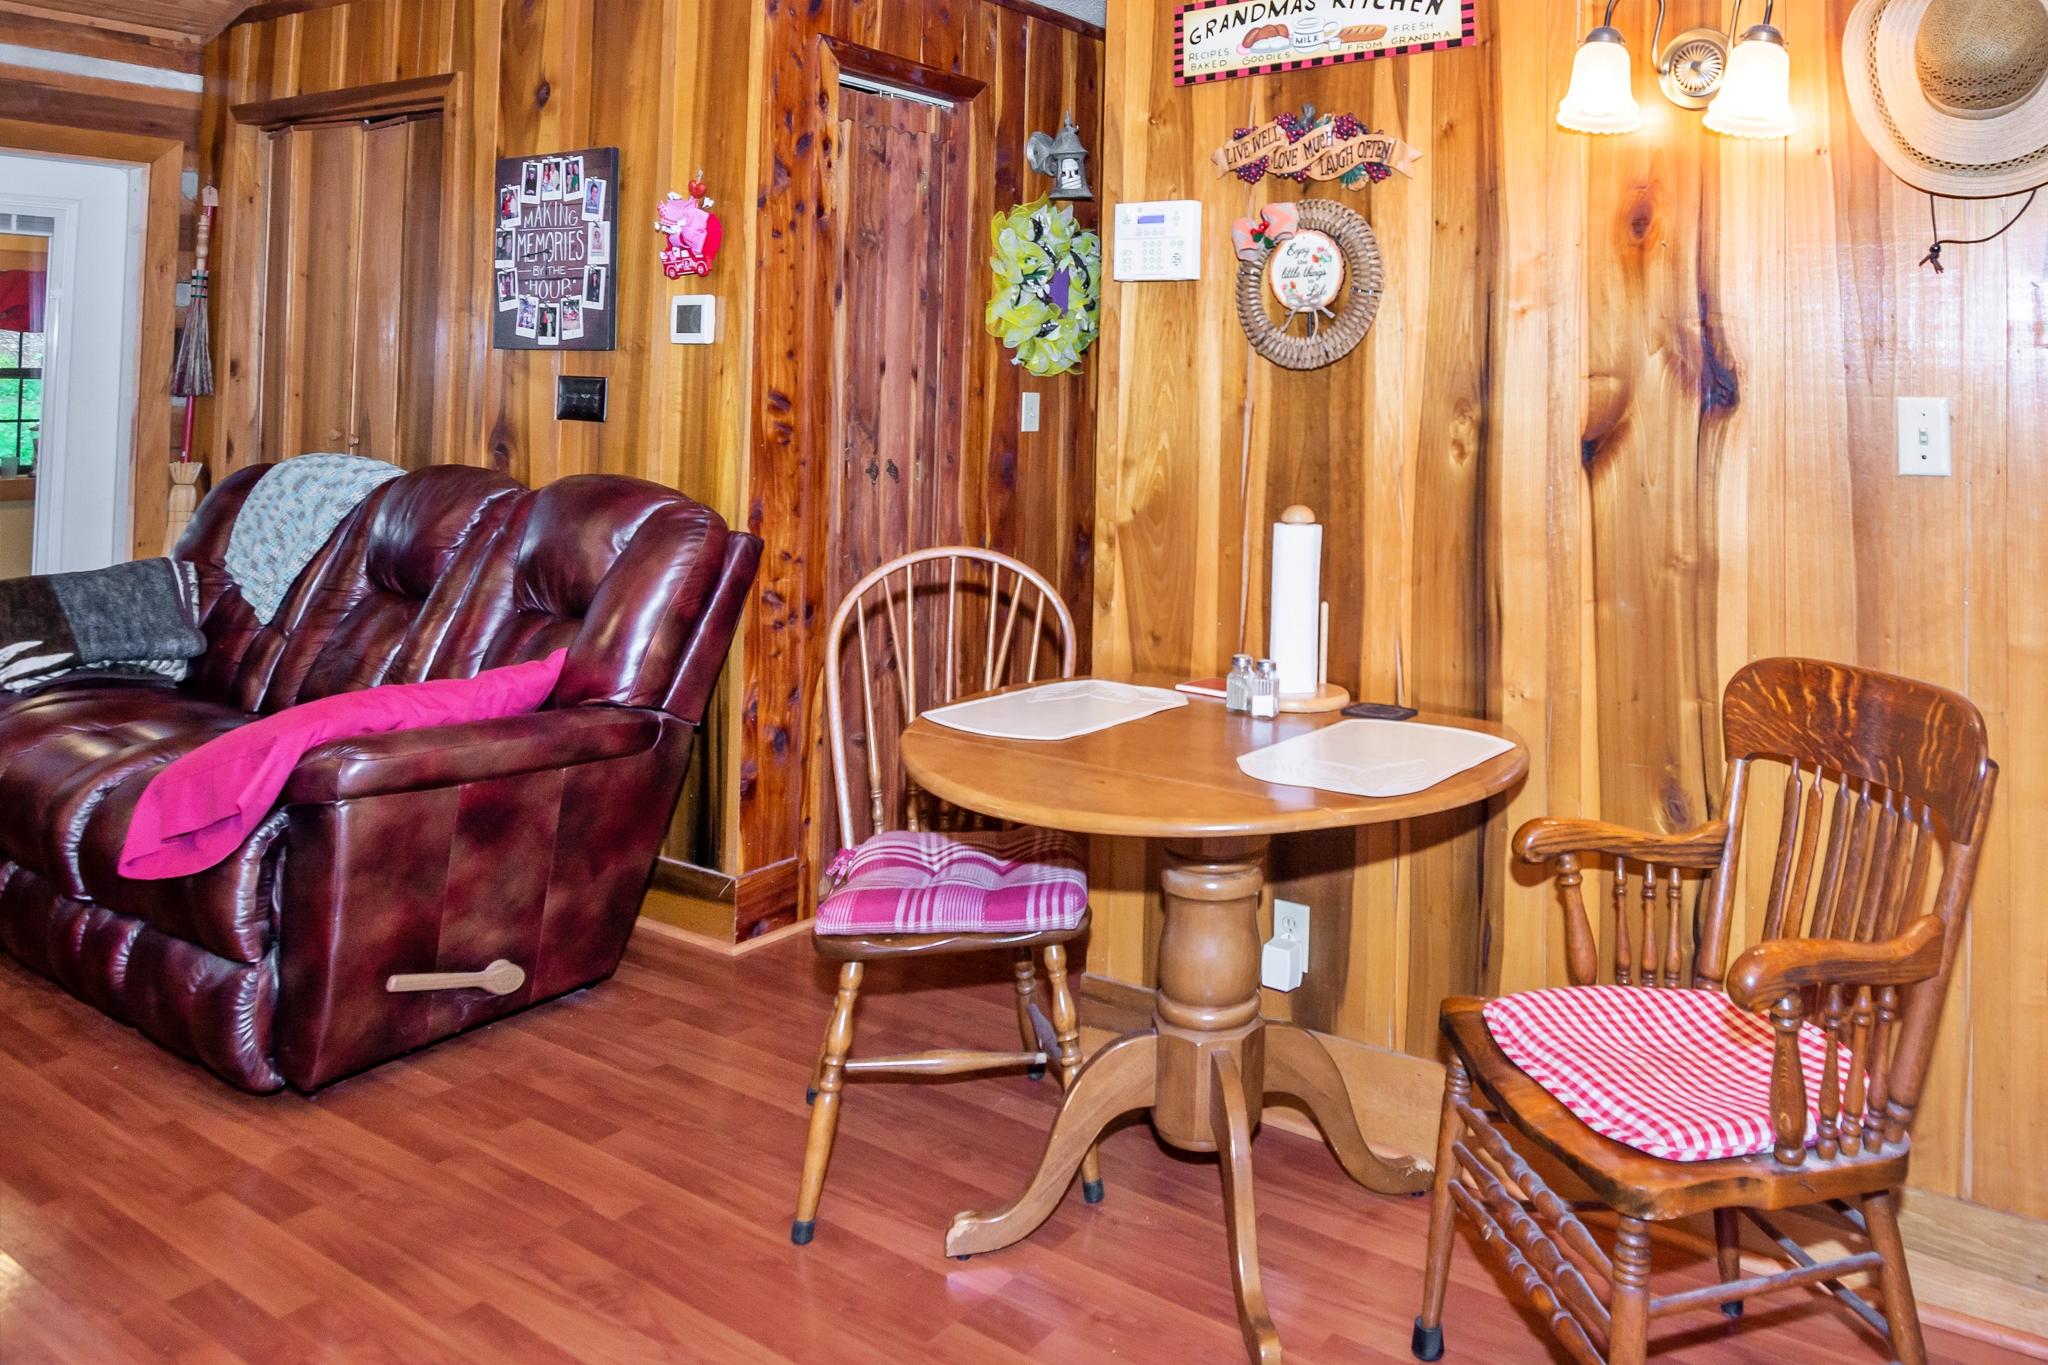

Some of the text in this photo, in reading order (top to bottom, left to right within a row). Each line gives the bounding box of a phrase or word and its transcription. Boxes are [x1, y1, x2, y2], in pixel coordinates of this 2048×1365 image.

[1189, 0, 1316, 45] GRANDMAS
[1393, 21, 1434, 32] FRESH
[1295, 34, 1320, 45] MILK
[1347, 30, 1451, 51] FROM GRANDMA
[1188, 47, 1230, 62] RECIPES
[1190, 52, 1290, 71] BAKED GOODIES
[1225, 126, 1281, 165] LIVE WELL
[1273, 130, 1334, 169] LOVE MUCH
[1320, 140, 1391, 176] LAUGH OFTEN
[523, 201, 579, 228] MAKING
[517, 230, 584, 263] MEMORIES
[532, 264, 567, 276] BY THE
[529, 279, 572, 299] HOUR
